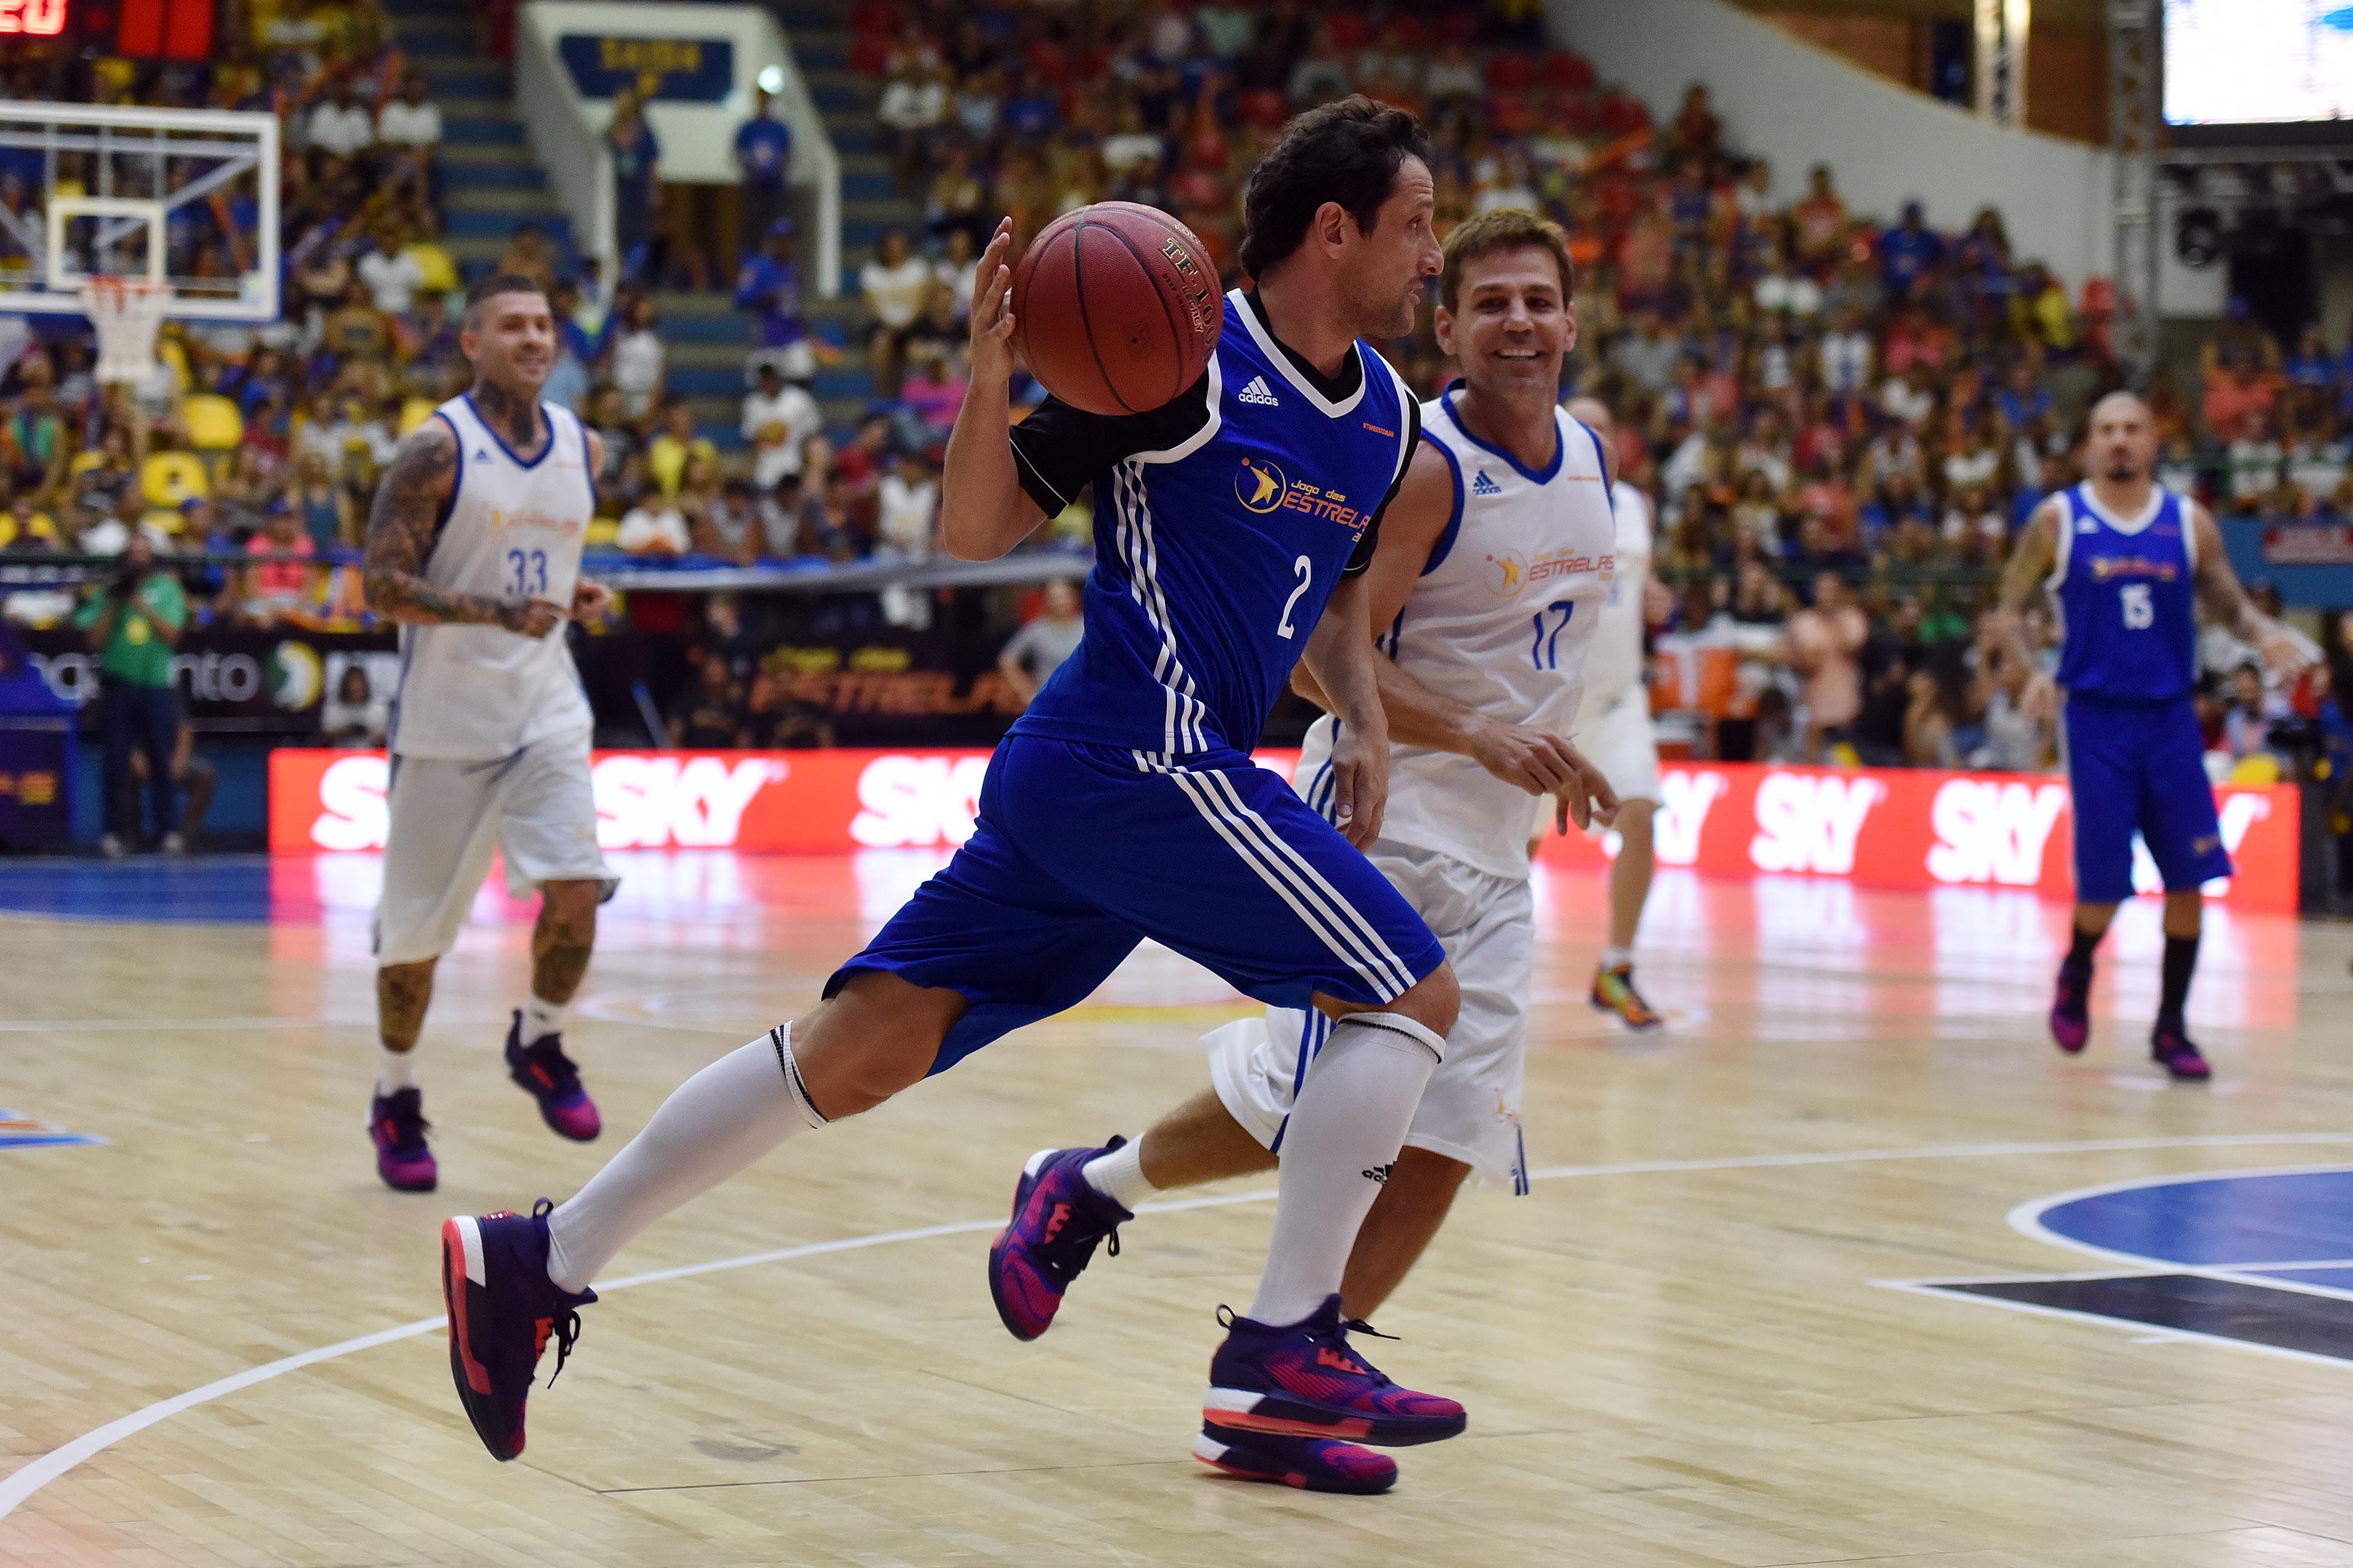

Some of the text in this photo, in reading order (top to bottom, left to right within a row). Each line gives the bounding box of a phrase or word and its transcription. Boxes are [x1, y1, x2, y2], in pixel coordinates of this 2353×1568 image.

[1182, 285, 1204, 333] LEGACY
[1238, 393, 1279, 407] adidas
[1282, 491, 1372, 532] ESTRELA
[1291, 480, 1346, 502] Jogo das
[507, 547, 548, 595] 33
[1277, 555, 1312, 640] 2
[1528, 555, 1614, 581] ESTRELAS
[1532, 600, 1574, 671] 17
[584, 756, 764, 847] SKY
[848, 755, 990, 846] SK
[1748, 771, 1879, 875] SKY
[1926, 779, 2066, 886] SKY
